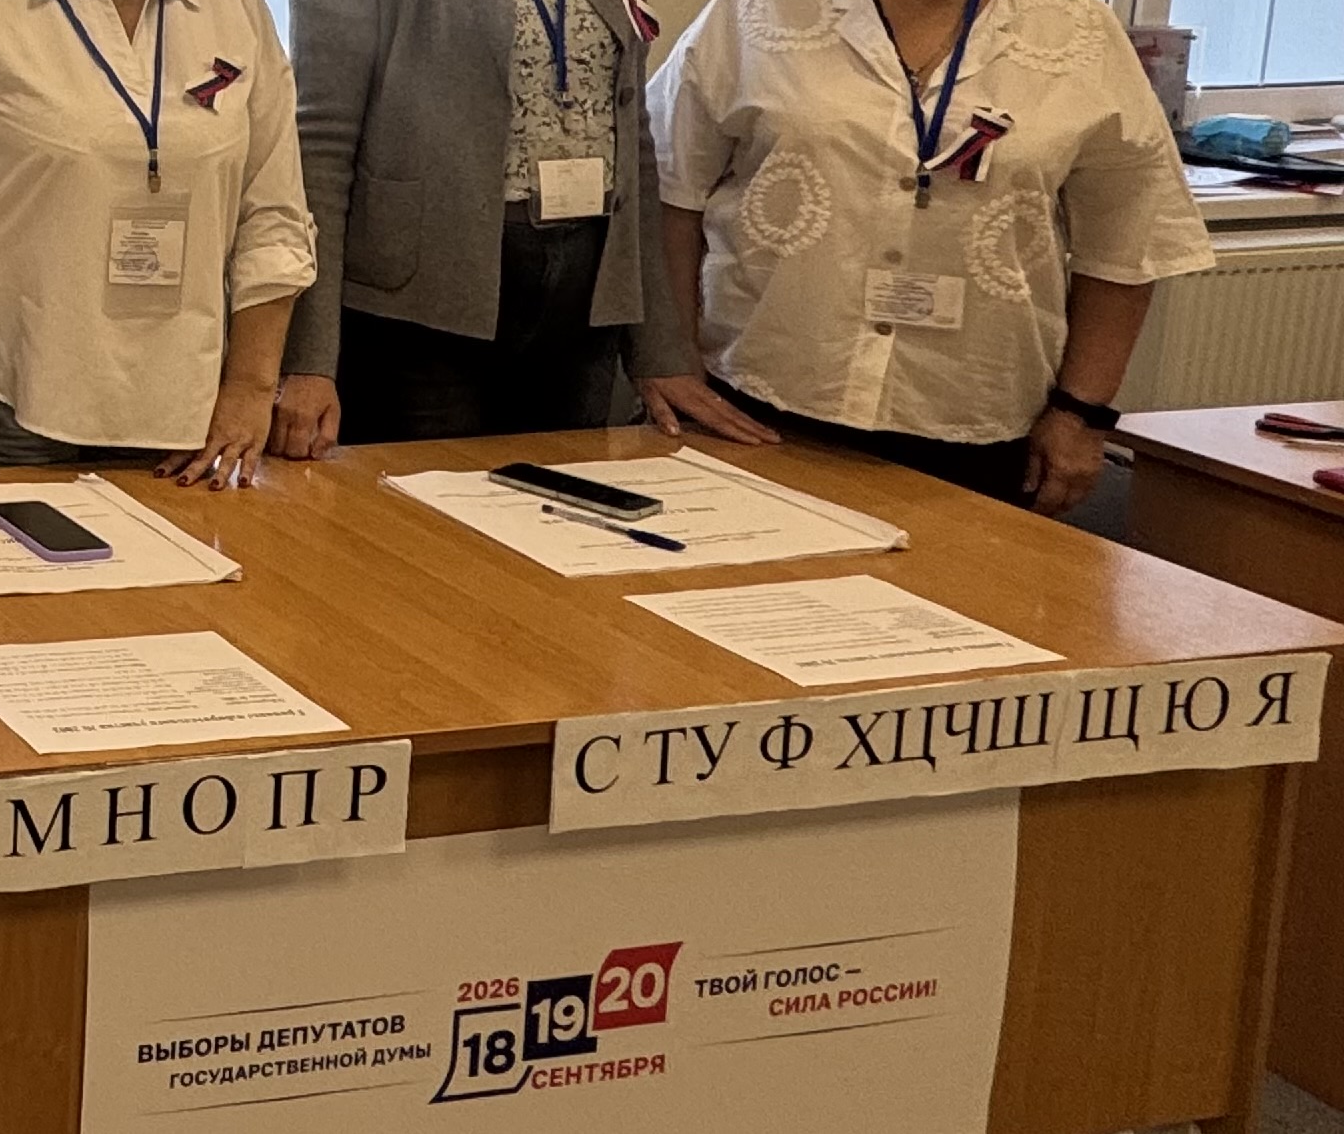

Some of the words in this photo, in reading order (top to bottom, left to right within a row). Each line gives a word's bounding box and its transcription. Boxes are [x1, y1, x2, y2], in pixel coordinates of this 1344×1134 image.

[456, 977, 520, 1003] 2026
[694, 969, 757, 998] ТВОЙ
[764, 963, 841, 990] ГОЛОС
[769, 992, 832, 1017] СИЛА
[838, 979, 938, 1009] РОССИИ!
[137, 1032, 251, 1063] ВЫБОРЫ
[257, 1015, 406, 1054] ДЕПУТАТОВ
[463, 1030, 516, 1078] 18
[531, 994, 585, 1044] 19
[598, 962, 665, 1014] 20
[169, 1047, 367, 1089] ГОСУДАРСТВЕННОЙ
[371, 1043, 432, 1068] ДУМЫ
[531, 1054, 666, 1090] СЕНТЯБРЯ
